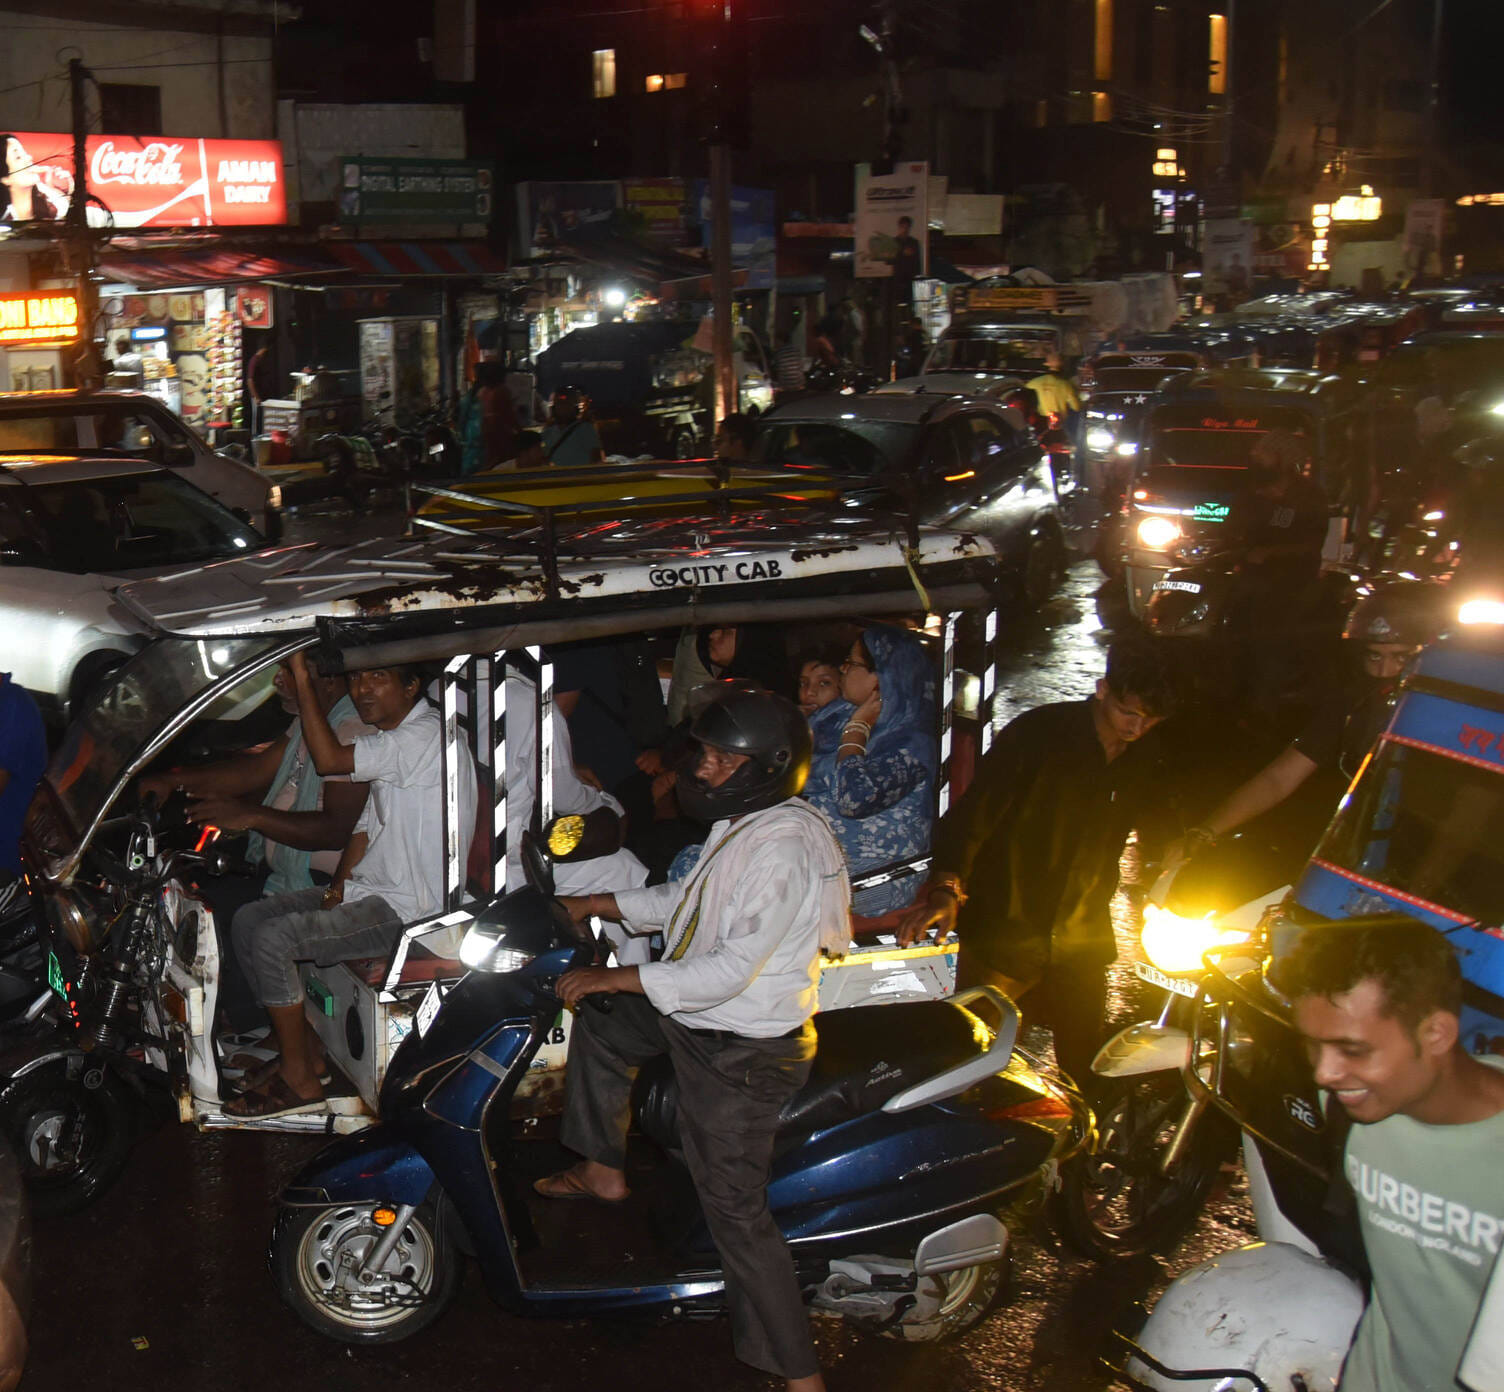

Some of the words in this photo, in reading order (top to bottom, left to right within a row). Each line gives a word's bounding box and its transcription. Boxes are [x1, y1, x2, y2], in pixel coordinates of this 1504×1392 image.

[217, 160, 276, 183] AMAN
[224, 185, 271, 204] DAIRY
[27, 296, 78, 327] BAND
[678, 564, 729, 586] CITY
[735, 560, 783, 581] CAB
[1347, 1153, 1504, 1255] BURBERR
